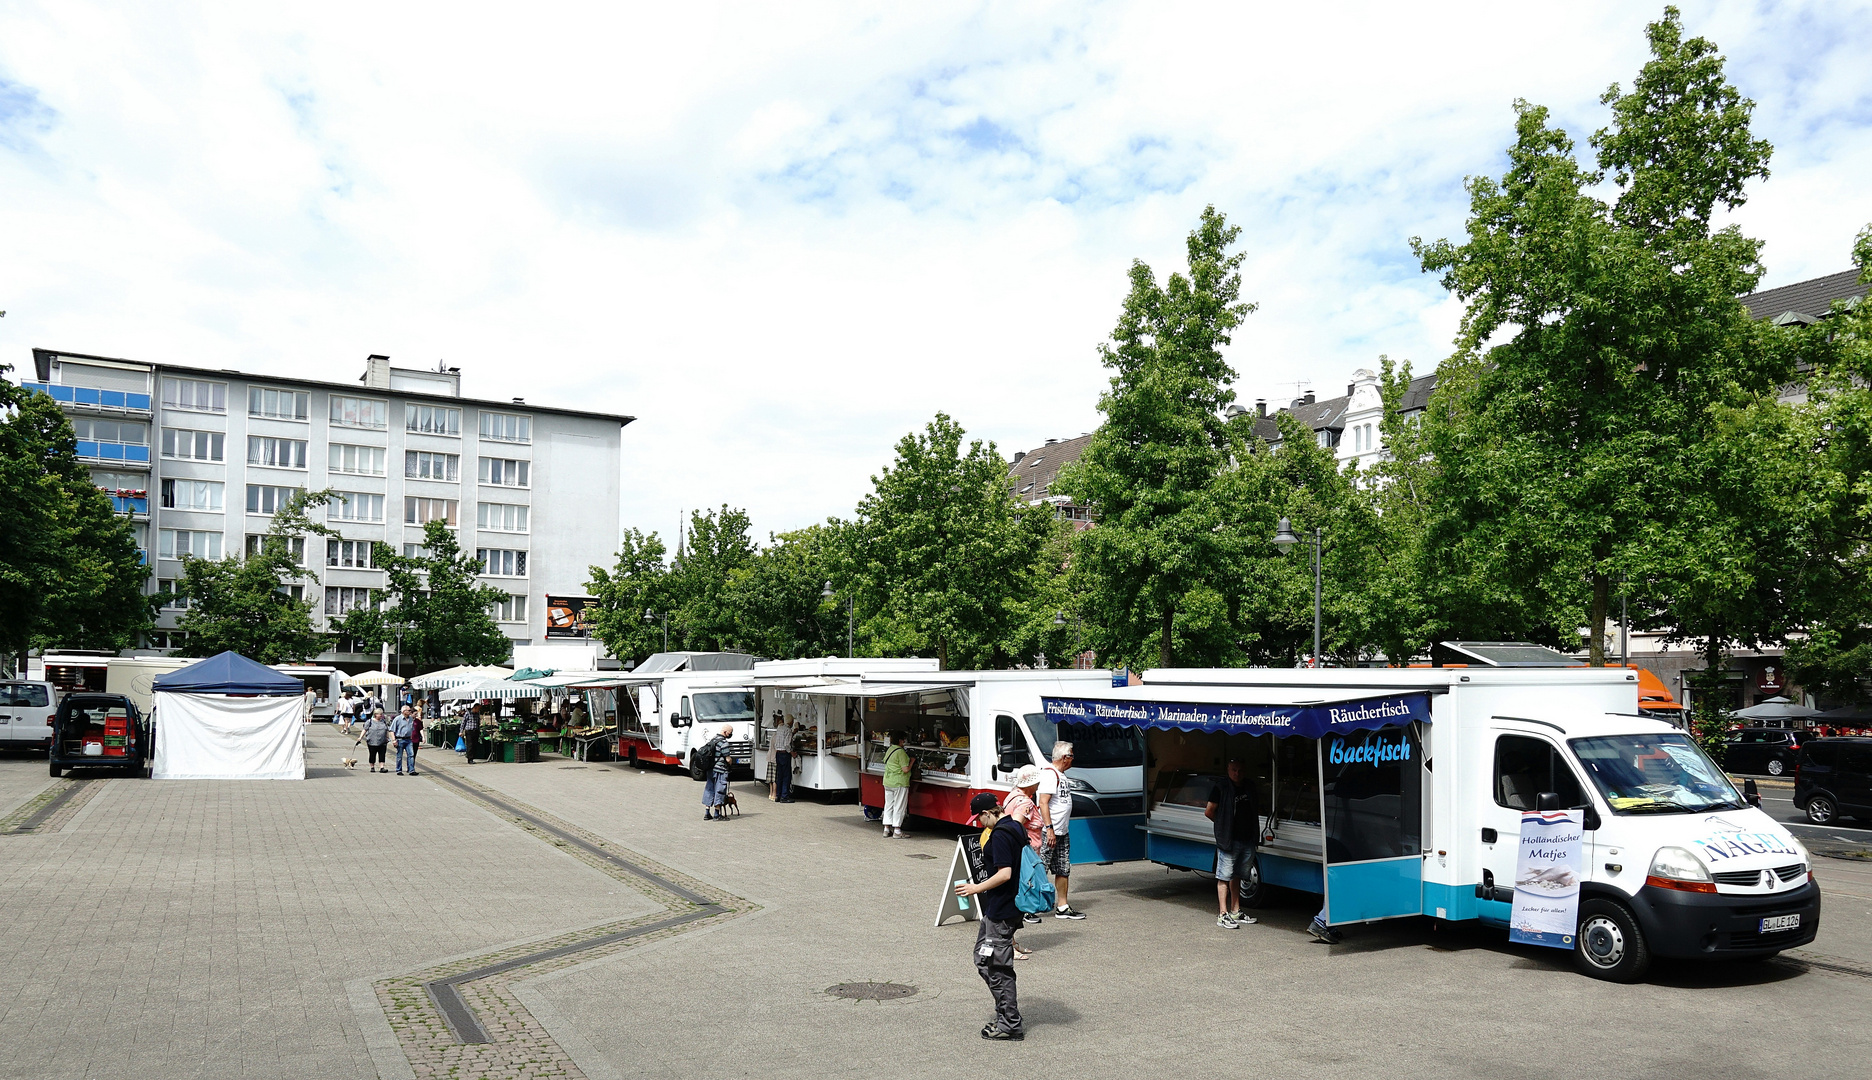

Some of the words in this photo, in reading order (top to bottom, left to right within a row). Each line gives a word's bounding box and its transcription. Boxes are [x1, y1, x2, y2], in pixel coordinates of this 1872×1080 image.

[1047, 701, 1085, 716] Frischfisch
[1095, 703, 1147, 719] Räucherfisch
[1158, 706, 1208, 722] Marinaden
[1220, 708, 1291, 727] Feinkostsalate
[1329, 699, 1411, 724] Räucherfisch
[1330, 735, 1410, 768] Backfisch
[1522, 833, 1581, 844] Holländischer
[1529, 849, 1567, 861] Matjes
[1763, 919, 1772, 929] GL
[1776, 916, 1786, 928] LE
[1786, 915, 1799, 927] 126
